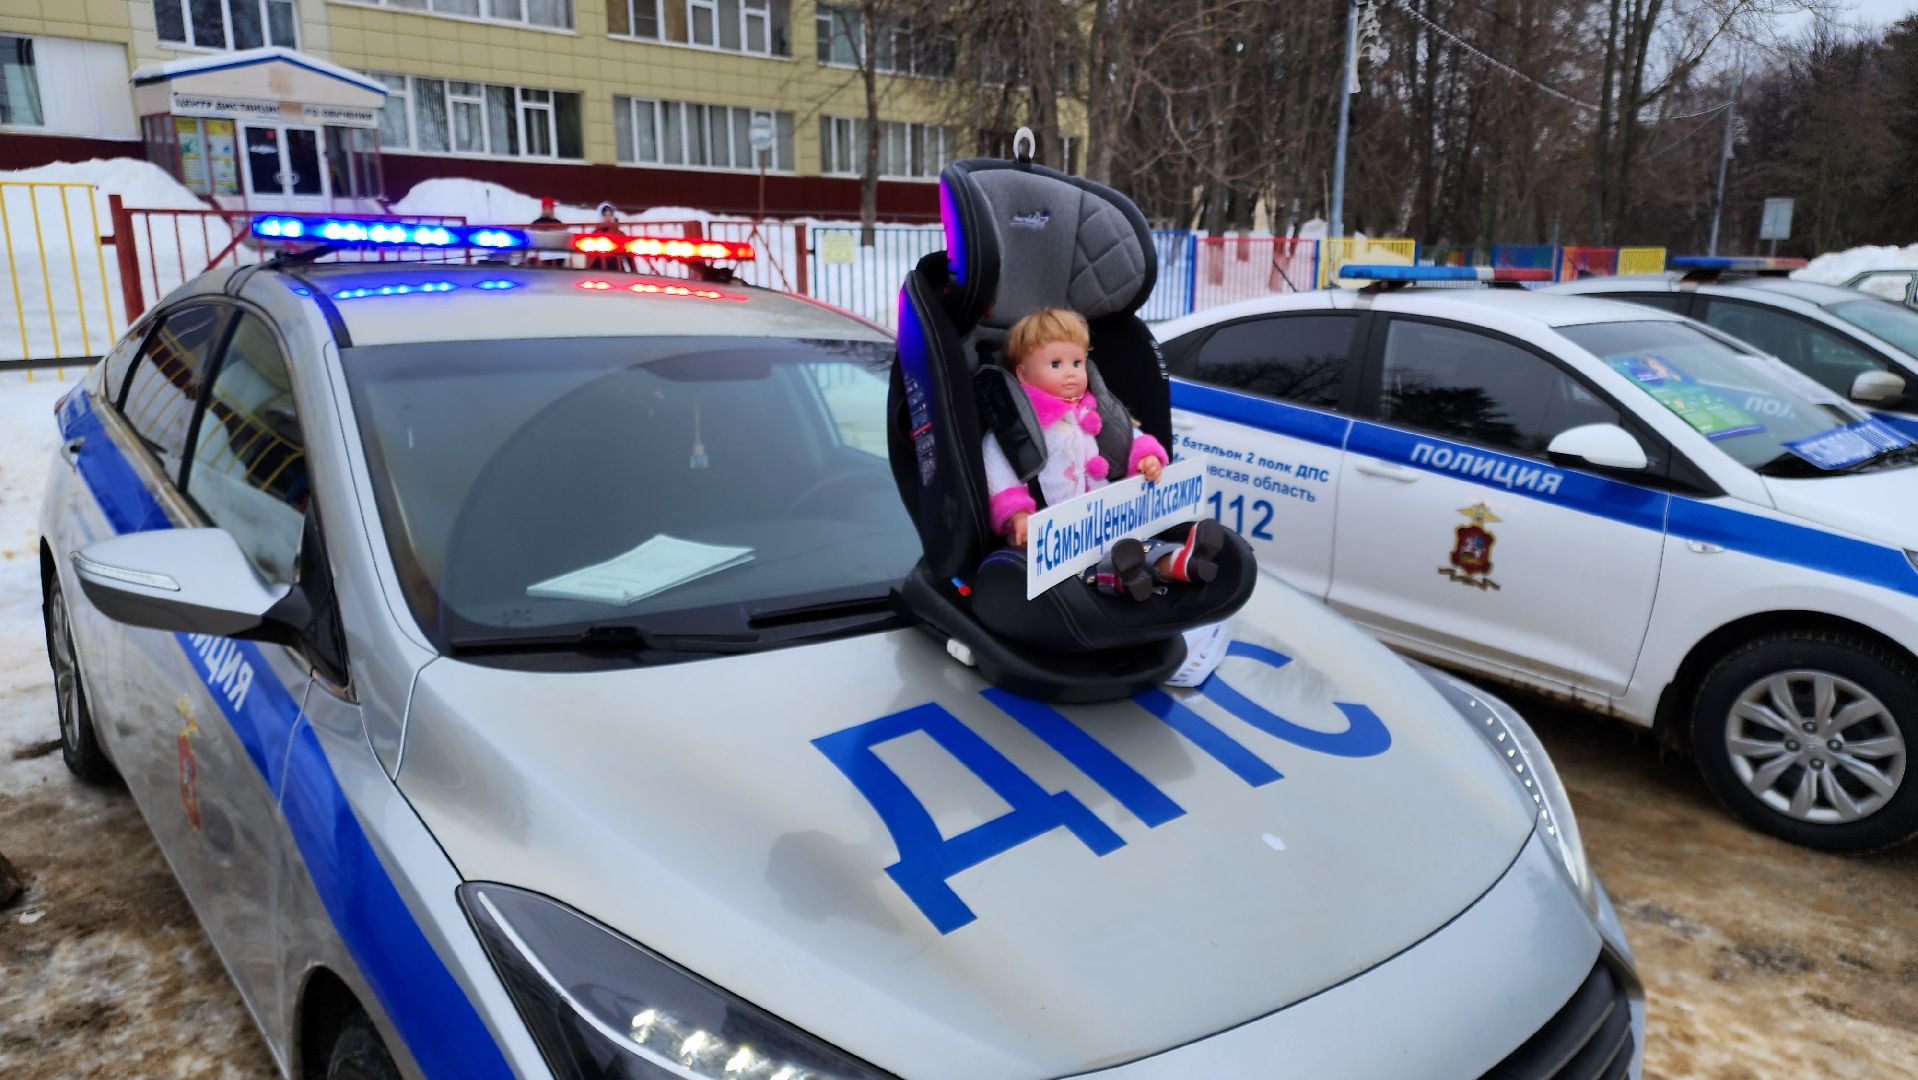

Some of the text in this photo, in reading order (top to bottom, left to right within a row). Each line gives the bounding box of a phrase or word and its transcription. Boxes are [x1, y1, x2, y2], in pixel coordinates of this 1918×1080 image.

[1182, 436, 1243, 463] батальон
[1246, 452, 1255, 464] 2
[1258, 457, 1293, 474] полк
[1295, 464, 1330, 483] ДПС
[1410, 443, 1564, 495] ПОЛИЦИЯ
[1207, 490, 1275, 541] 112
[1253, 476, 1317, 503] область
[1035, 474, 1203, 577] #СамыйЦенныйПассажир
[187, 632, 255, 713] ИЦИЯ
[810, 640, 1392, 935] ДПС
